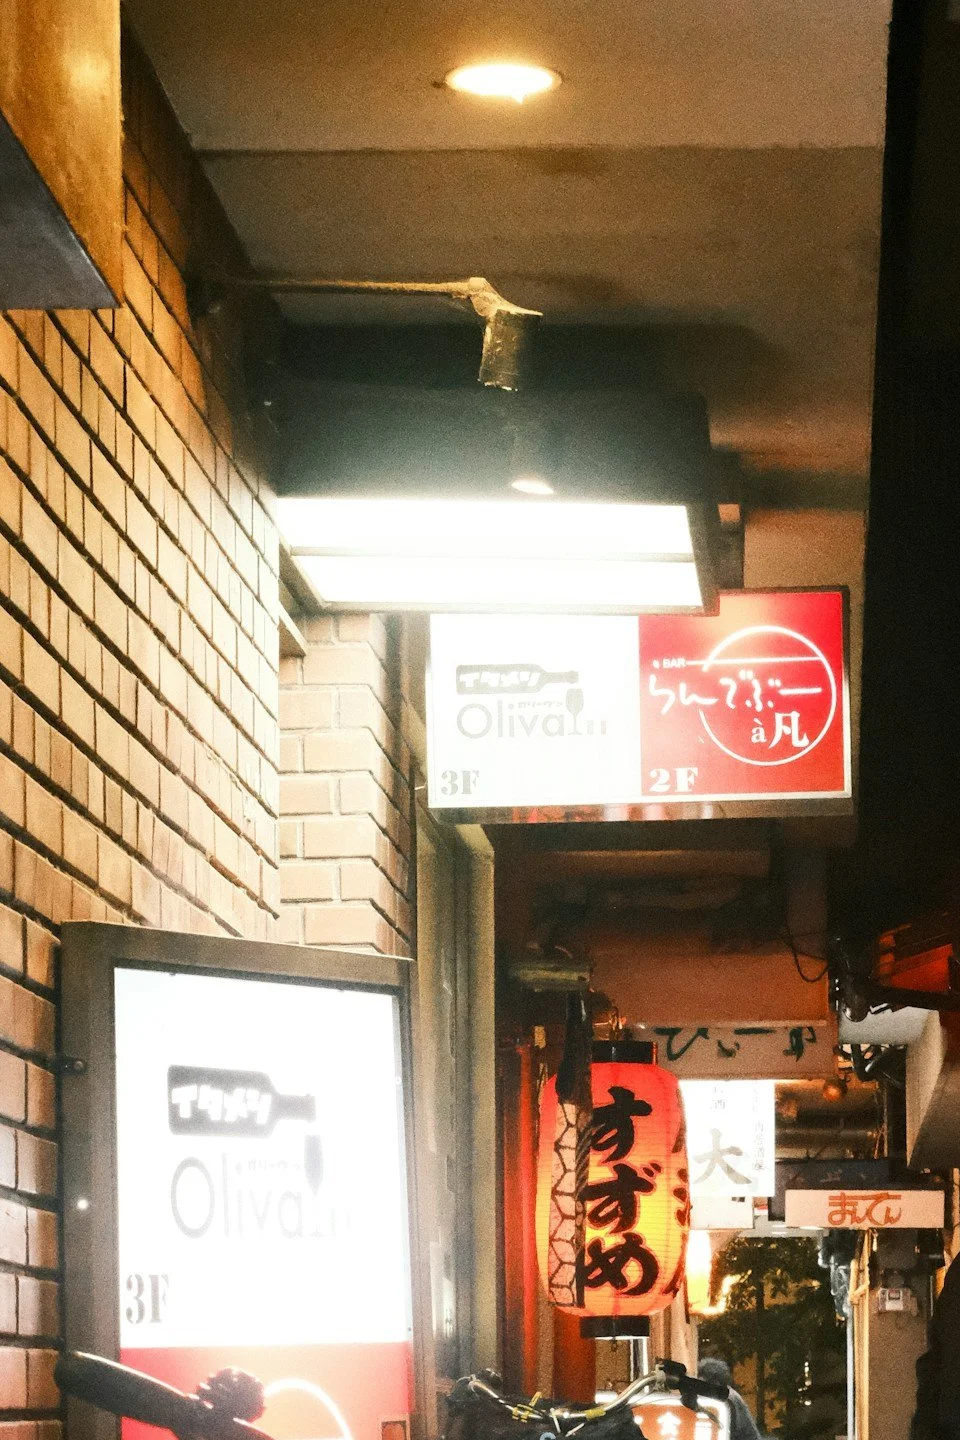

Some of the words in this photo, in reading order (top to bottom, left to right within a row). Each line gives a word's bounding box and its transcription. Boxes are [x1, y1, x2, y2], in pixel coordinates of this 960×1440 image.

[662, 658, 686, 669] BAR
[440, 769, 480, 796] 3F
[649, 766, 699, 793] 2F
[579, 1086, 661, 1296] すずめ
[125, 1272, 170, 1325] 3F
